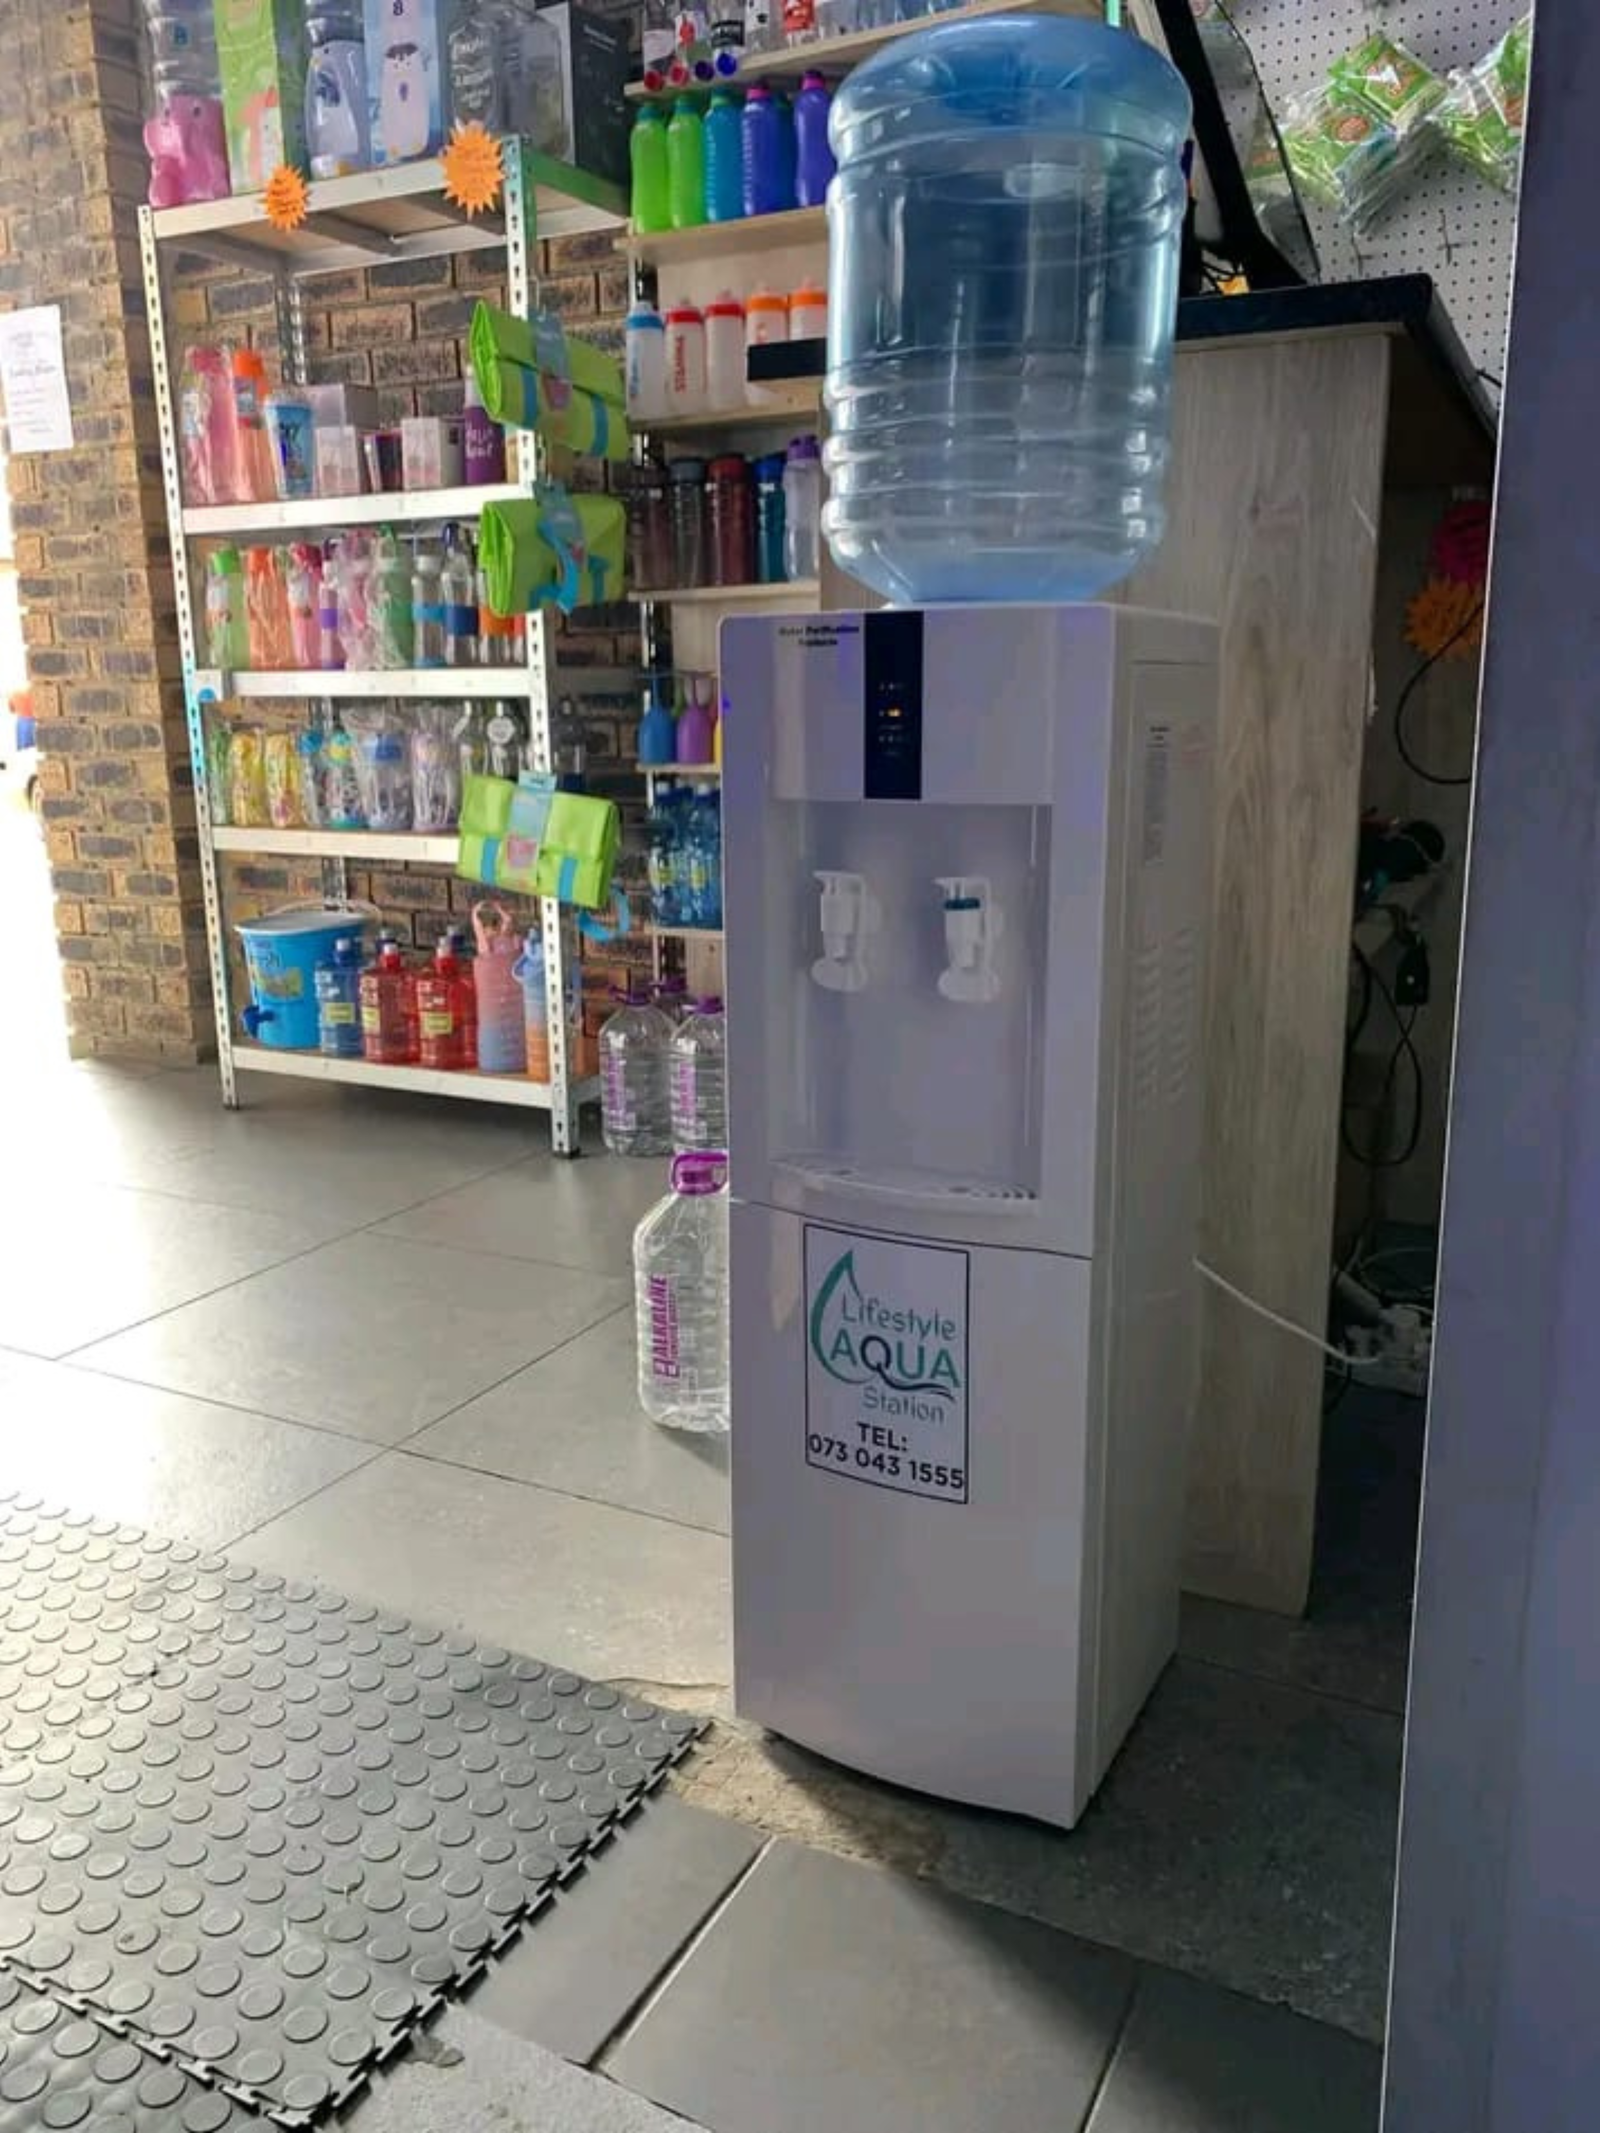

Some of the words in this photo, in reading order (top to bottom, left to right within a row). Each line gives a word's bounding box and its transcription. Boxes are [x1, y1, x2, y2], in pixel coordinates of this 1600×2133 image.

[648, 1274, 668, 1360] ALKALINE
[842, 1295, 956, 1341] Lifestyle
[829, 1328, 961, 1392] AQUA
[863, 1387, 945, 1425] Station
[856, 1421, 908, 1451] TEL:
[809, 1434, 848, 1462] 073
[856, 1450, 900, 1476] 043
[909, 1461, 965, 1489] 1555
